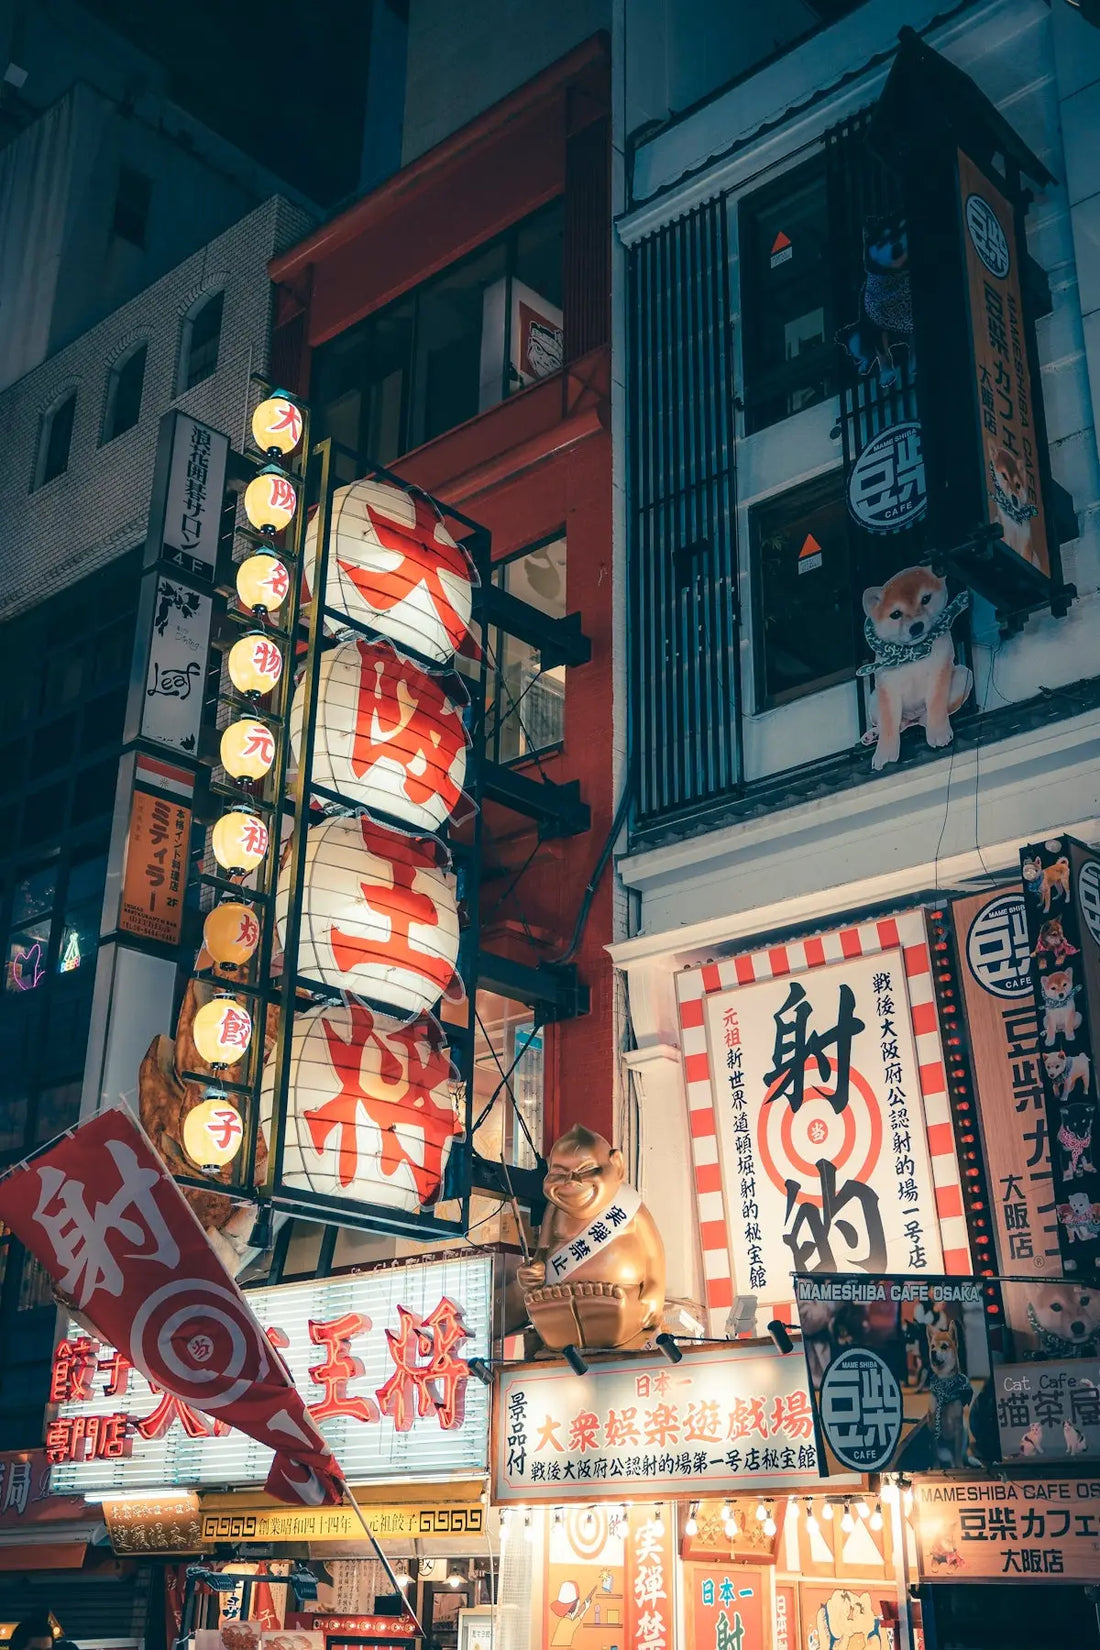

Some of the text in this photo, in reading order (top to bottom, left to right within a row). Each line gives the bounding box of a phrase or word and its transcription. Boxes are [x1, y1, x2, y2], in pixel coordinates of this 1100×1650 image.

[884, 501, 913, 519] CAFE
[147, 661, 201, 700] Leaf
[166, 896, 179, 908] 2F
[988, 907, 1009, 919] MAME
[1005, 976, 1032, 990] CAFE
[872, 971, 928, 1269] 戦後大阪府公認射的場一号店
[33, 1139, 181, 1306] 射
[999, 1173, 1034, 1260] 大阪店
[551, 1205, 628, 1276] 実弾禁止
[800, 1283, 980, 1302] MAMESHIBA CAFE OSAKA
[842, 1361, 878, 1369] MAME SHIBA
[635, 1371, 692, 1398] 日本一
[1003, 1376, 1031, 1392] Cat
[532, 1390, 814, 1453] 大衆娯楽遊戯場
[825, 1369, 900, 1448] 豆柴
[46, 1413, 136, 1463] 専門店
[506, 1391, 528, 1477] 景品付
[531, 1445, 817, 1482] 戦後大阪府公認射的場第一号店秘宝館
[853, 1450, 877, 1459] CAFE
[921, 1486, 1019, 1503] MAMESHIBA
[1023, 1484, 1069, 1500] CAFE
[959, 1507, 1099, 1541] 豆柴カフェ
[1000, 1548, 1064, 1574] 大阪店
[702, 1577, 754, 1608] 日本一
